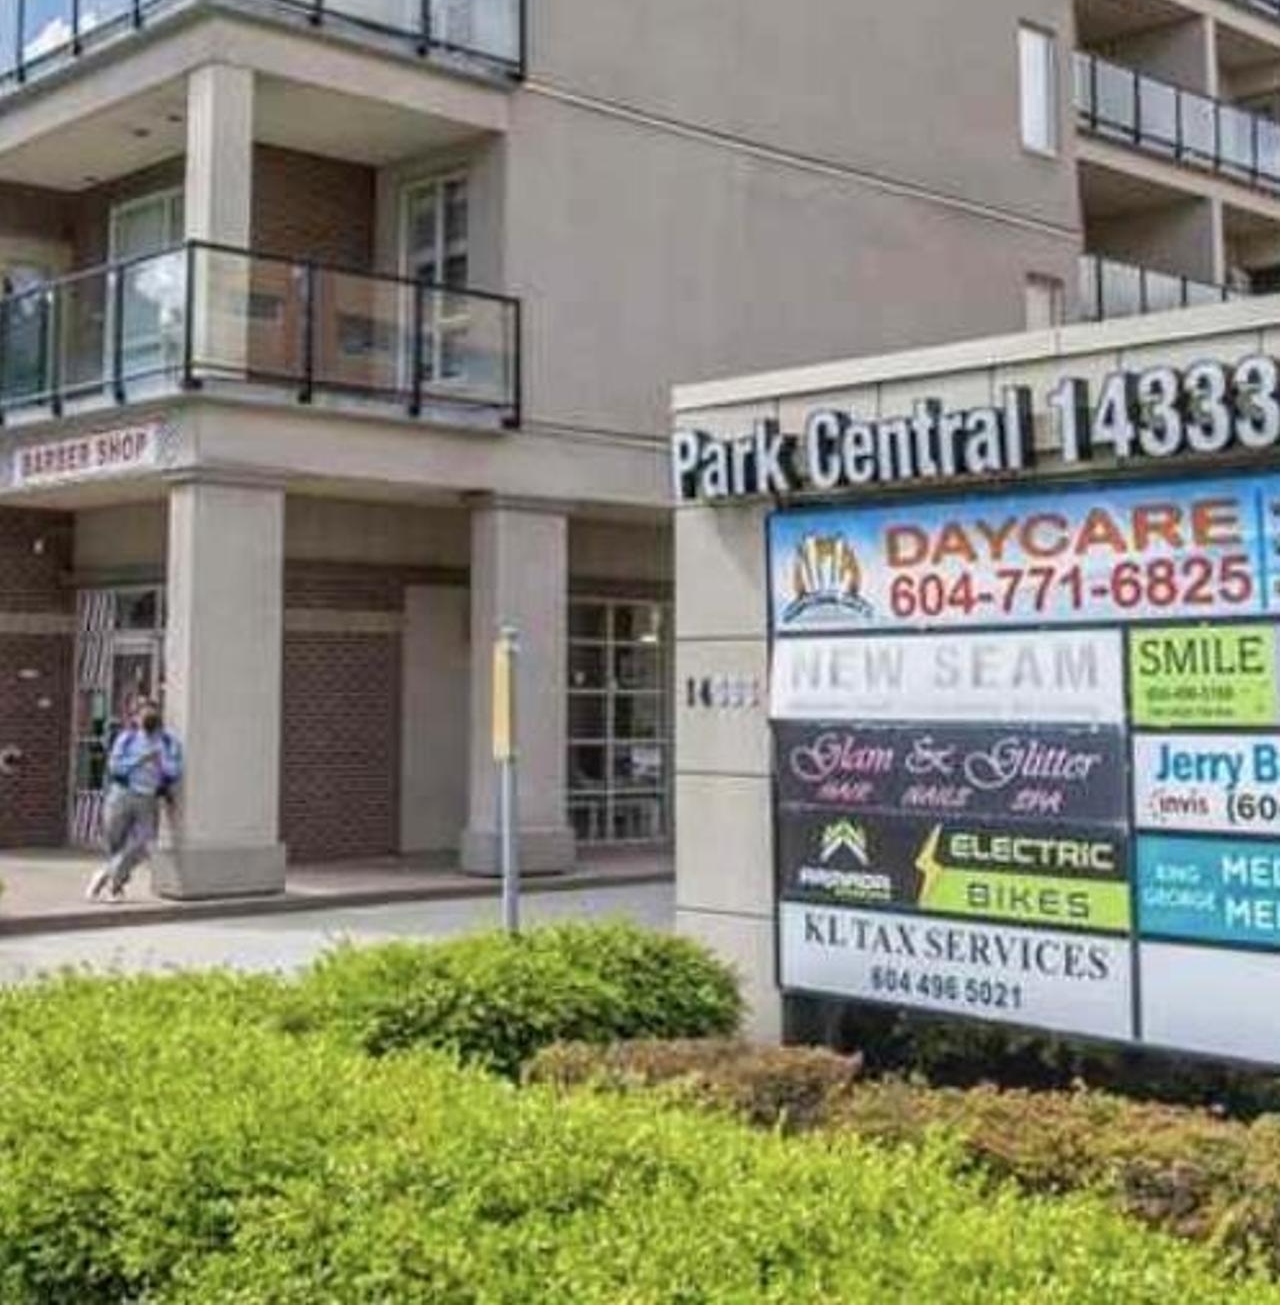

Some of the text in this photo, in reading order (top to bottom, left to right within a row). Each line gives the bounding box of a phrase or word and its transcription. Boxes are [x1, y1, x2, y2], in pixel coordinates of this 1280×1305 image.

[22, 432, 146, 477] BARBER SHOP
[672, 417, 792, 499] Park
[805, 385, 1032, 488] Central
[886, 500, 1242, 567] DAYCARE
[890, 556, 1251, 618] 604-771-6825
[790, 639, 1100, 693] NEW SEAM
[1139, 635, 1265, 676] SMILE
[790, 731, 894, 781] Glam
[963, 735, 1103, 789] Glitter
[1154, 741, 1246, 791] Jerry
[950, 833, 1116, 871] ELECTRIC
[966, 880, 1092, 920] BIKES
[852, 917, 917, 957] TAX
[922, 925, 1110, 981] SERVICES
[870, 964, 912, 992] 604
